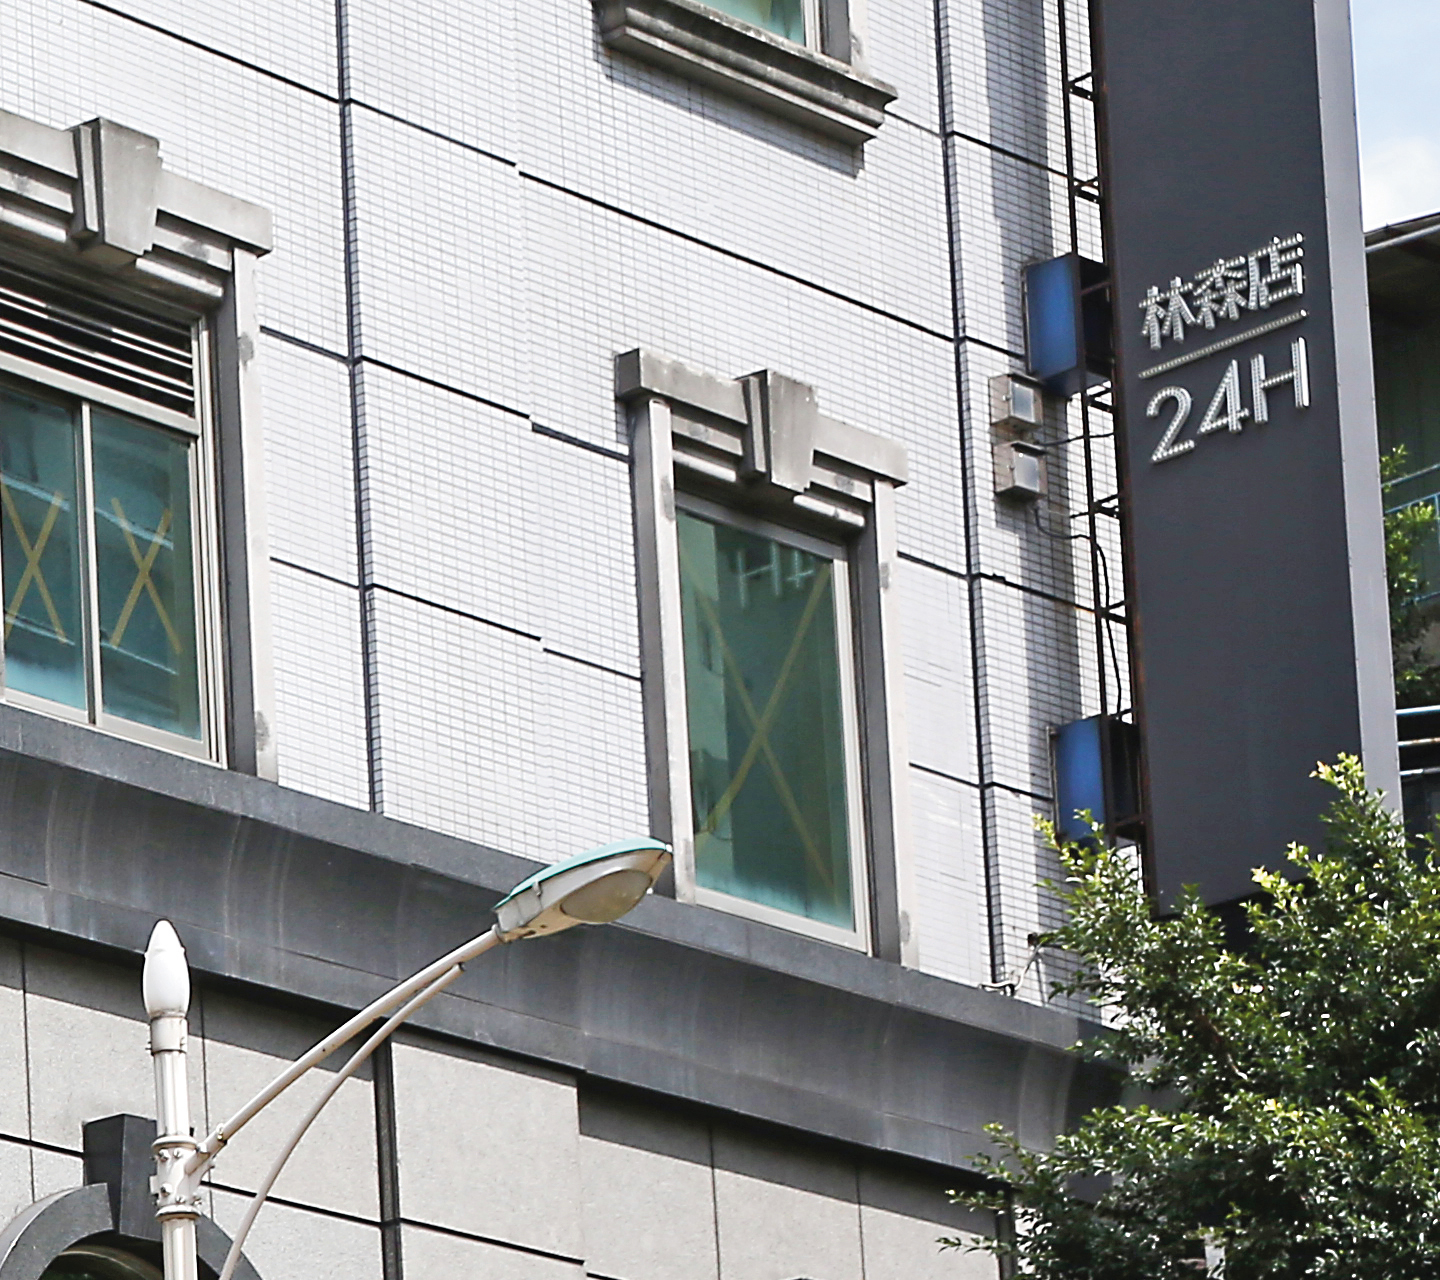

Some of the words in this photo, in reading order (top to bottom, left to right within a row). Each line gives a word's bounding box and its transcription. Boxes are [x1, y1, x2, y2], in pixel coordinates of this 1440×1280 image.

[1139, 232, 1305, 350] 林森店
[1146, 336, 1309, 464] 24H
